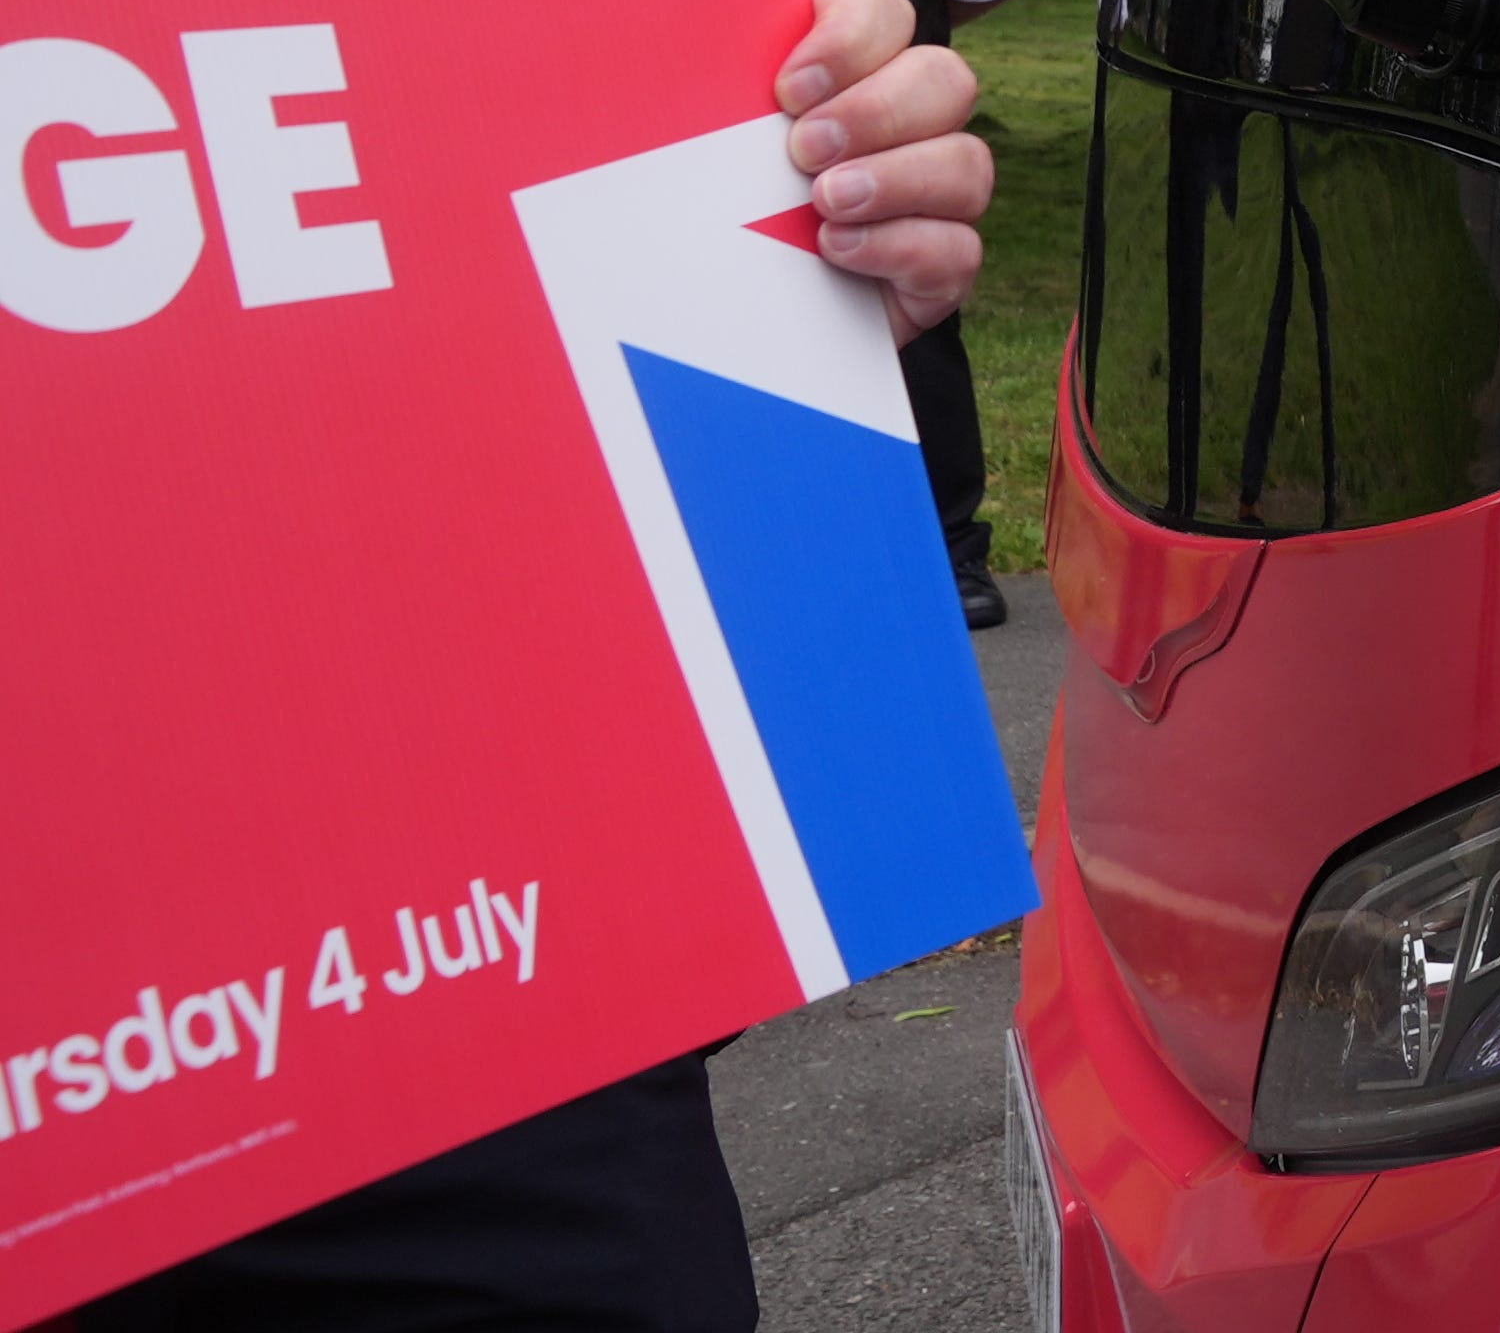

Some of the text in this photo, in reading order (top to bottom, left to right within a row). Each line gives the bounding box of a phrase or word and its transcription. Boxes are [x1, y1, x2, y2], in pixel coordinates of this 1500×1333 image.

[0, 879, 538, 1145] rsday 4 July
